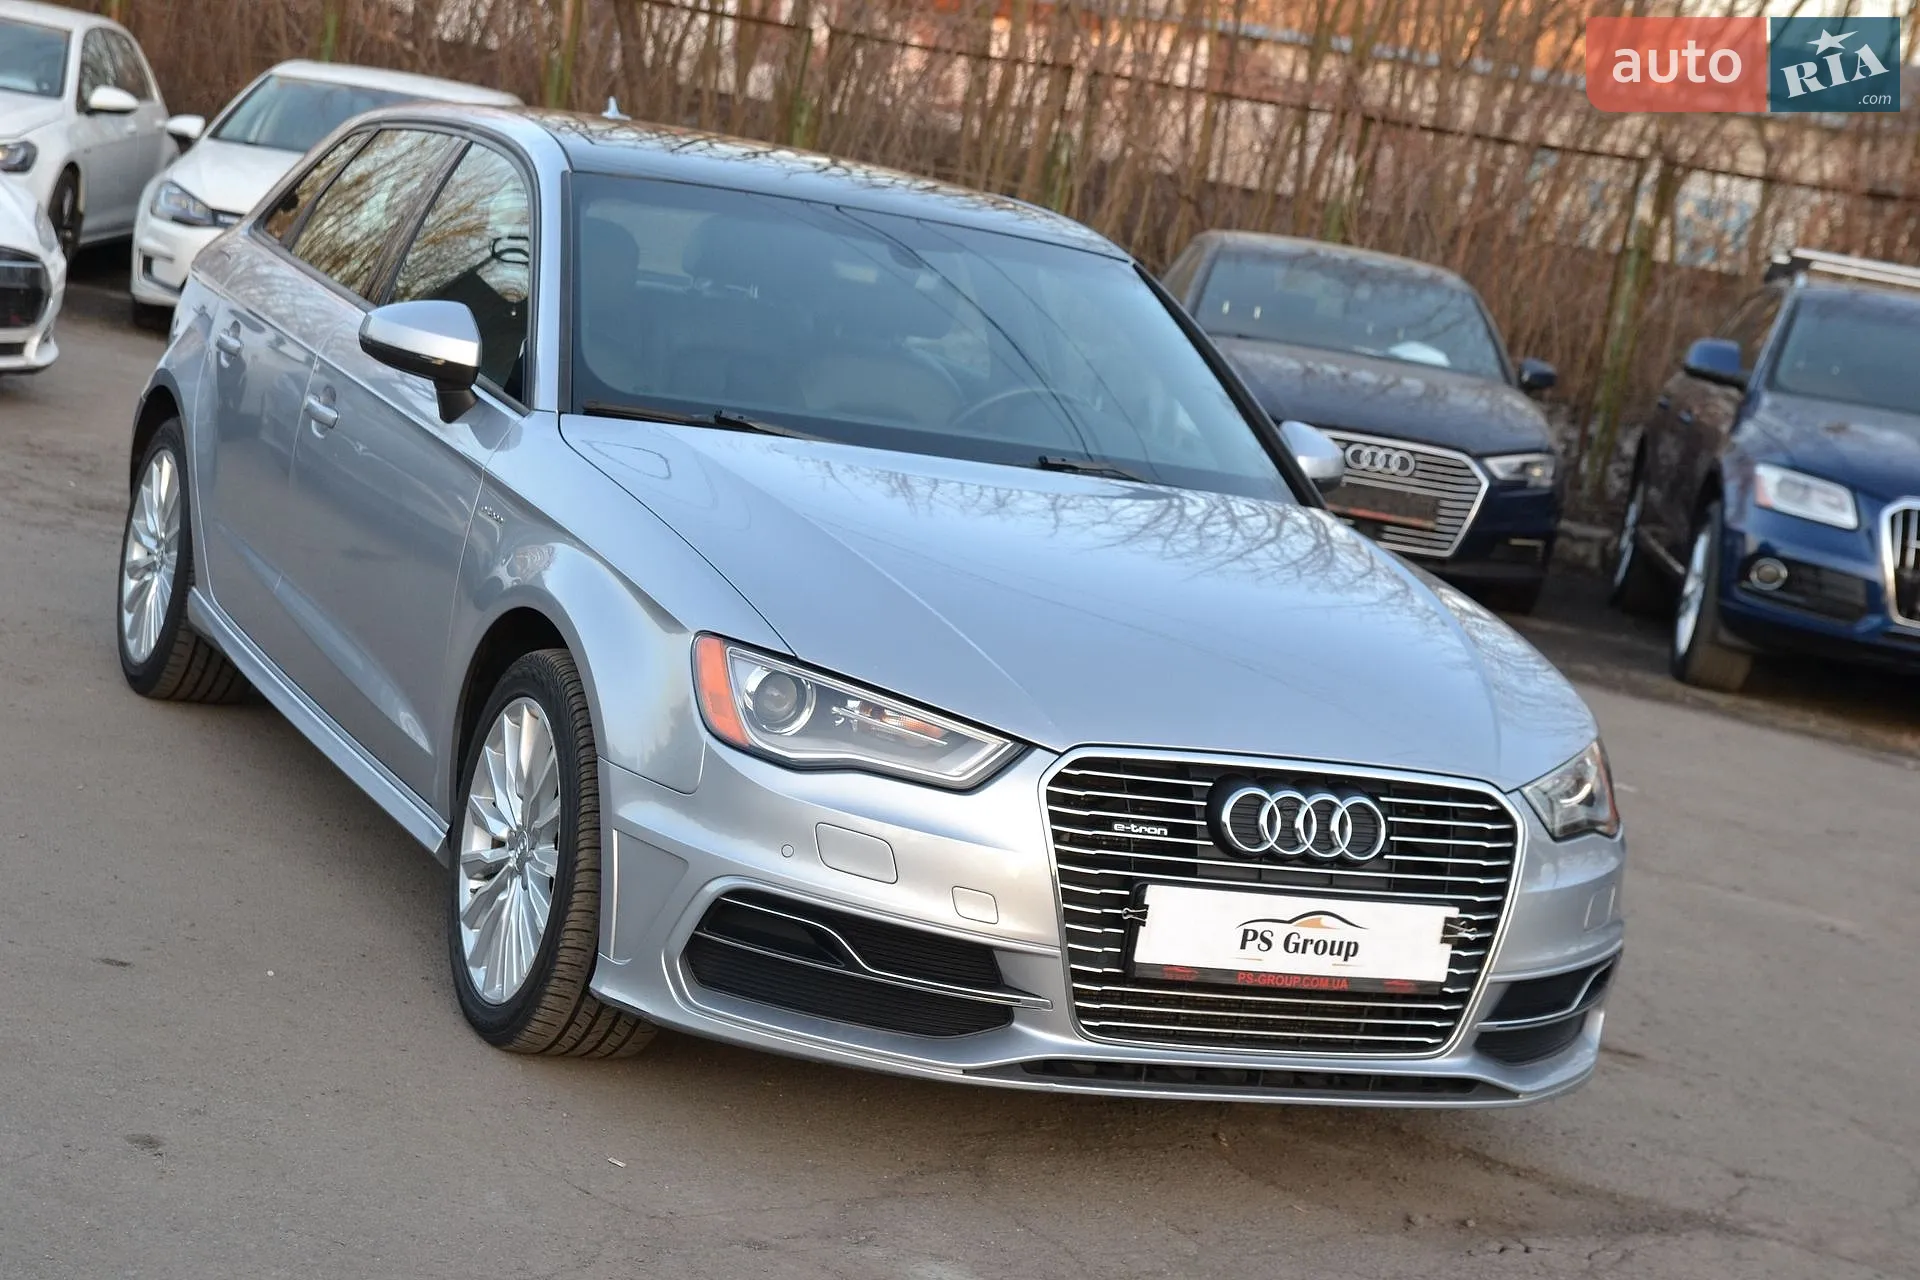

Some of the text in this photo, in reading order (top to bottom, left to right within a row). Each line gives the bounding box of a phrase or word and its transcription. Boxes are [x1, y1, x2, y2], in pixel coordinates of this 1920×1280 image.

[1113, 823, 1168, 836] e-tron
[1239, 928, 1359, 962] PS Group
[1237, 971, 1349, 990] PS-GROUP.COM.UA
